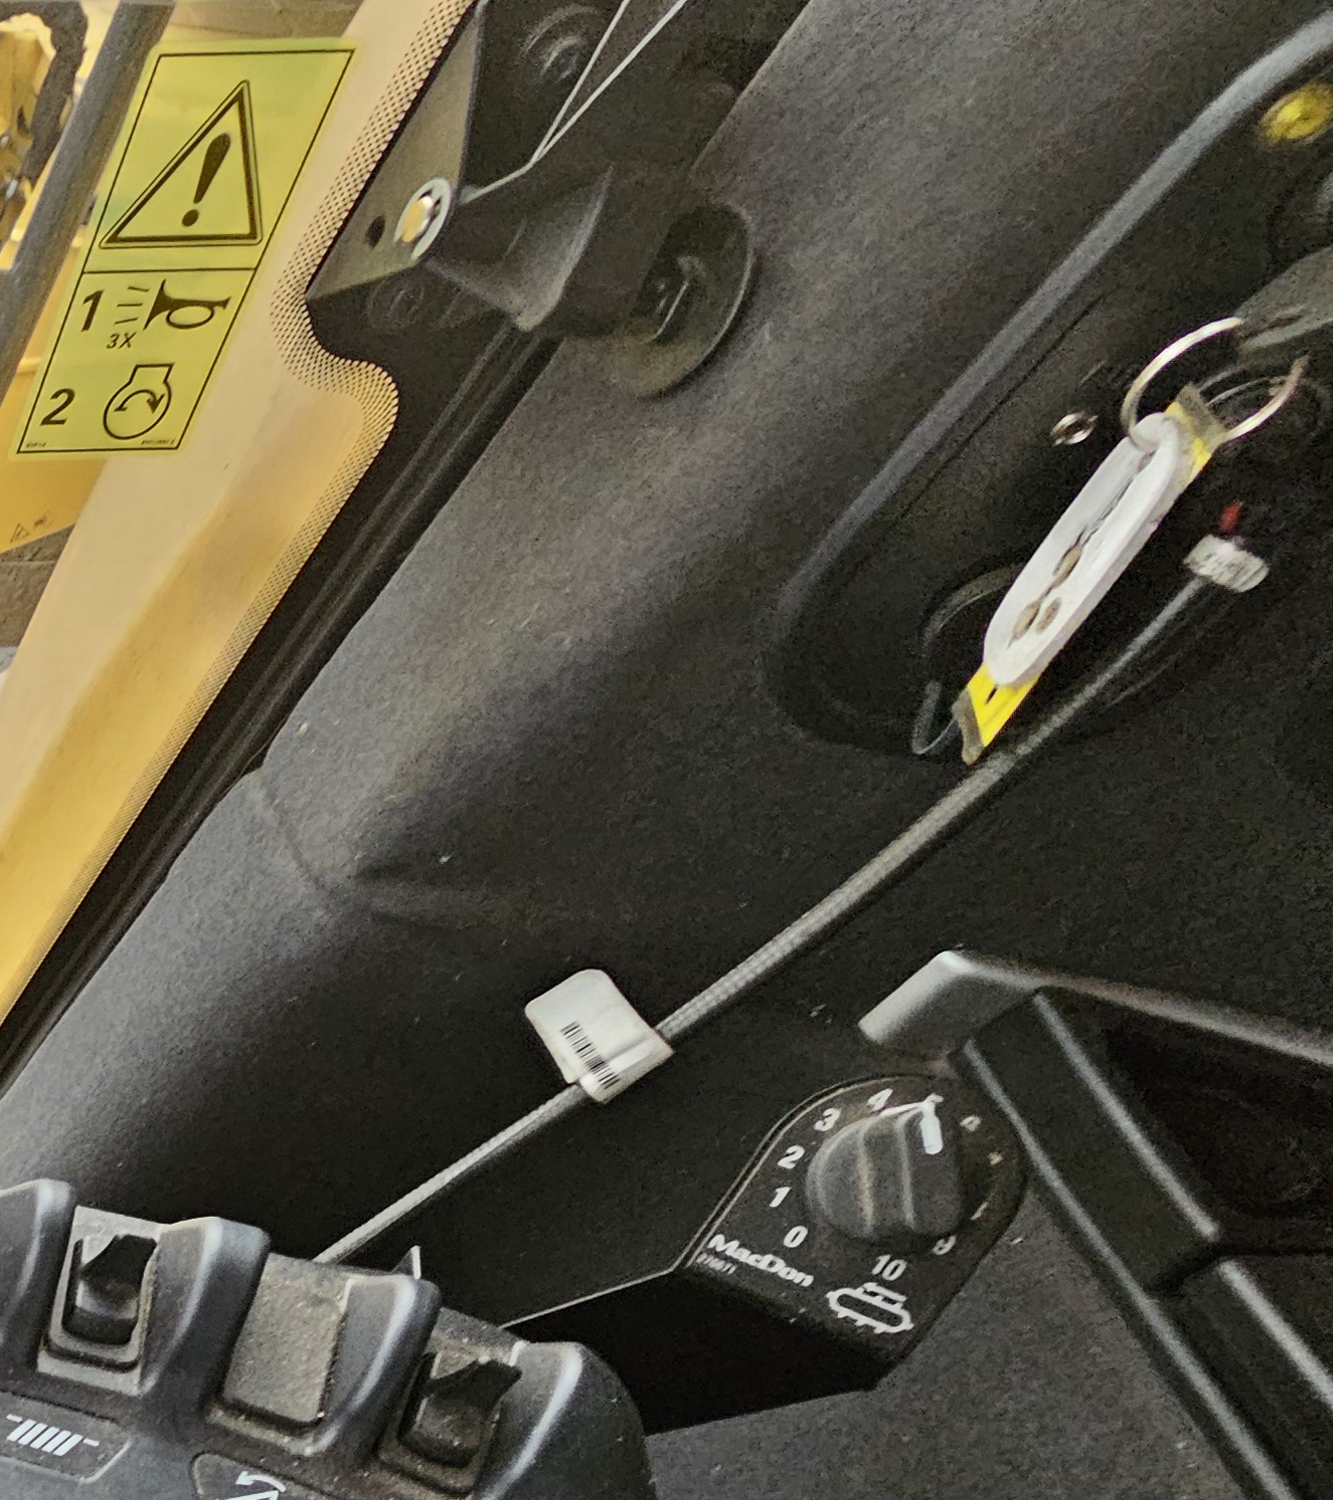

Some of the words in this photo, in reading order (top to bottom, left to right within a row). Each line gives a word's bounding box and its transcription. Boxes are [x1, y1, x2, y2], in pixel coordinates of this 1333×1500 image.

[81, 289, 104, 332] 1
[106, 332, 136, 349] 3X
[40, 388, 75, 426] 2
[867, 1088, 893, 1111] 4
[814, 1108, 841, 1132] 3
[777, 1145, 805, 1169] 2
[769, 1186, 792, 1208] 1
[783, 1225, 808, 1248] 0
[707, 1234, 814, 1287] MacDon
[871, 1254, 908, 1281] 10
